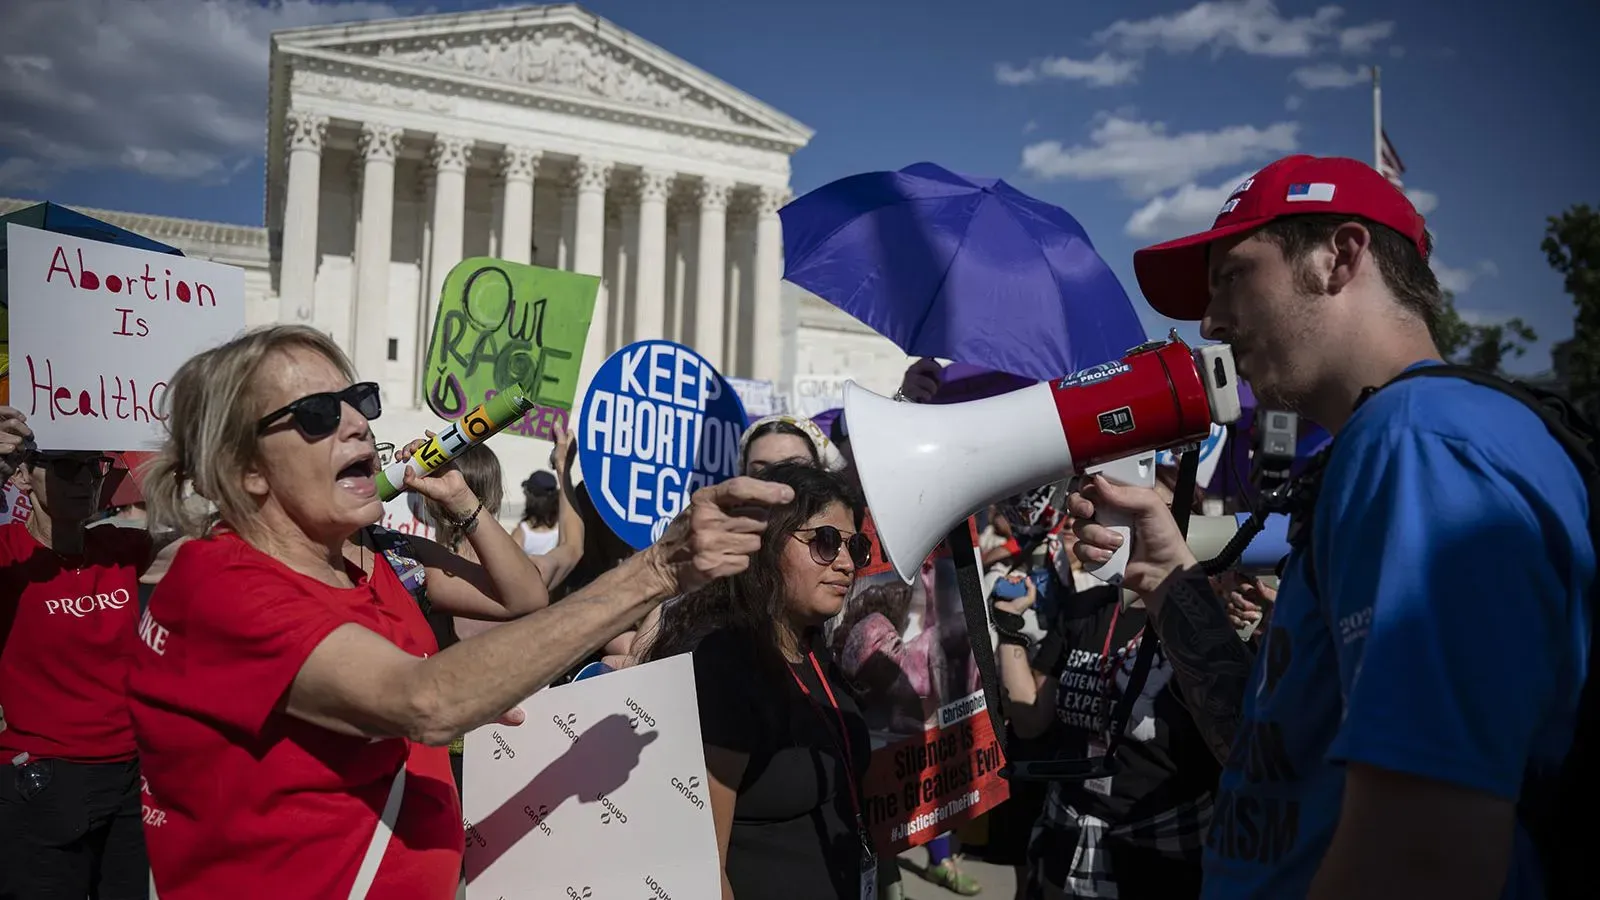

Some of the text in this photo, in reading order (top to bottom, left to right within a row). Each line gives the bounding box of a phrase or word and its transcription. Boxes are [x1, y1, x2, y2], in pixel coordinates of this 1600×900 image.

[47, 246, 216, 307] Abortion
[113, 308, 149, 337] Is
[463, 266, 548, 348] Our
[620, 344, 722, 411] KEEP
[1080, 364, 1130, 383] PROLOVE
[587, 389, 741, 477] ABORTION
[943, 694, 985, 724] Christopher
[1064, 692, 1118, 716] EXPET
[894, 732, 957, 780] Silence
[904, 754, 974, 811] Greatest
[975, 741, 1001, 777] Evil
[890, 788, 981, 842] #JusticeForTheFive
